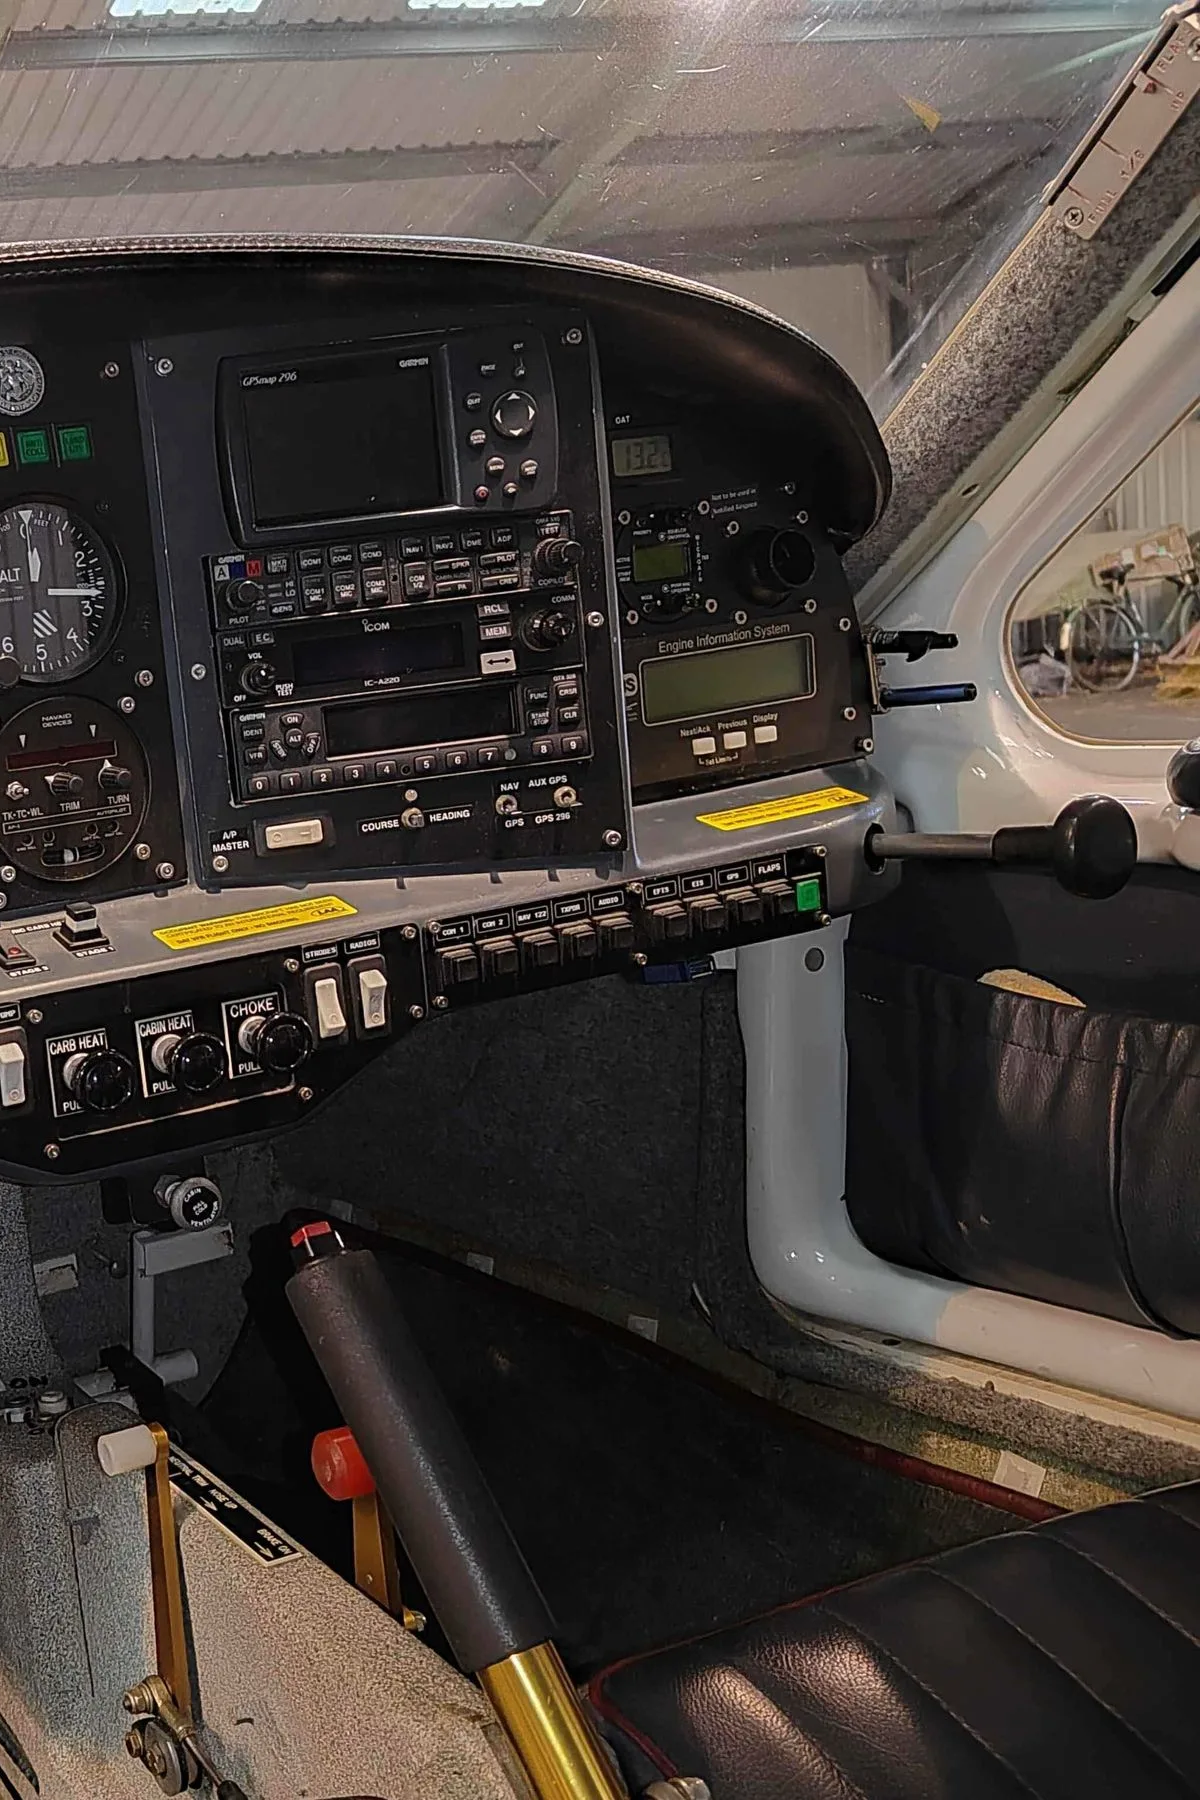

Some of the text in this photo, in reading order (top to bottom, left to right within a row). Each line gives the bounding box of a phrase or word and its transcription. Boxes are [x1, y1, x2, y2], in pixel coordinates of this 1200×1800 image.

[399, 357, 429, 367] GARMIN
[279, 372, 297, 382] 296
[540, 526, 559, 535] TEST
[467, 538, 482, 547] DME
[75, 552, 86, 567] 2
[497, 554, 516, 563] PILOT
[451, 560, 470, 569] SPKR
[0, 568, 20, 583] ALT
[499, 577, 518, 585] CREW
[335, 584, 355, 592] COM2
[552, 594, 575, 603] COMM
[81, 601, 92, 616] 3
[484, 604, 503, 614] RCL
[229, 616, 249, 624] PILOT
[66, 628, 78, 643] 4
[485, 626, 507, 636] MEM
[224, 637, 244, 646] DUAL
[659, 622, 790, 654] Engine Information System
[2, 637, 14, 652] 6
[36, 644, 48, 660] 5
[275, 682, 293, 691] PUSH
[364, 676, 400, 687] IC-A220
[234, 694, 246, 702] OFF
[530, 692, 548, 700] FUNC
[41, 713, 72, 721] NAVAID
[564, 711, 577, 719] CLR
[753, 712, 778, 723] Display
[42, 719, 72, 728] DEVICES
[718, 719, 747, 730] Previous
[244, 728, 262, 737] IDENT
[528, 775, 568, 787] AUX GPS
[501, 782, 520, 791] NAV
[107, 795, 130, 805] TURN
[60, 801, 80, 812] TRIM
[97, 807, 127, 816] AUTOPILOT
[430, 810, 470, 822] HEADING
[535, 812, 571, 824] GPS 296
[362, 819, 399, 832] COURSE
[505, 818, 524, 828] GPS
[223, 831, 237, 839] A/P
[212, 841, 249, 852] MASTER
[758, 863, 780, 874] FLAPS
[691, 878, 704, 887] EIS
[653, 886, 669, 896] EFIS
[482, 920, 496, 928] COM
[350, 939, 377, 950] RADIOS
[76, 948, 107, 957] STAGE
[305, 948, 336, 958] STROBES
[9, 967, 41, 977] STAGE
[230, 999, 274, 1018] CHOKE
[140, 1015, 192, 1036] CABIN HEAT
[50, 1033, 105, 1055] CARB HEAT
[184, 1188, 201, 1202] CABIN
[190, 1200, 218, 1226] VENTILATOR
[209, 1489, 238, 1509] NOSE UP
[257, 1529, 293, 1554] BRAKE ON
